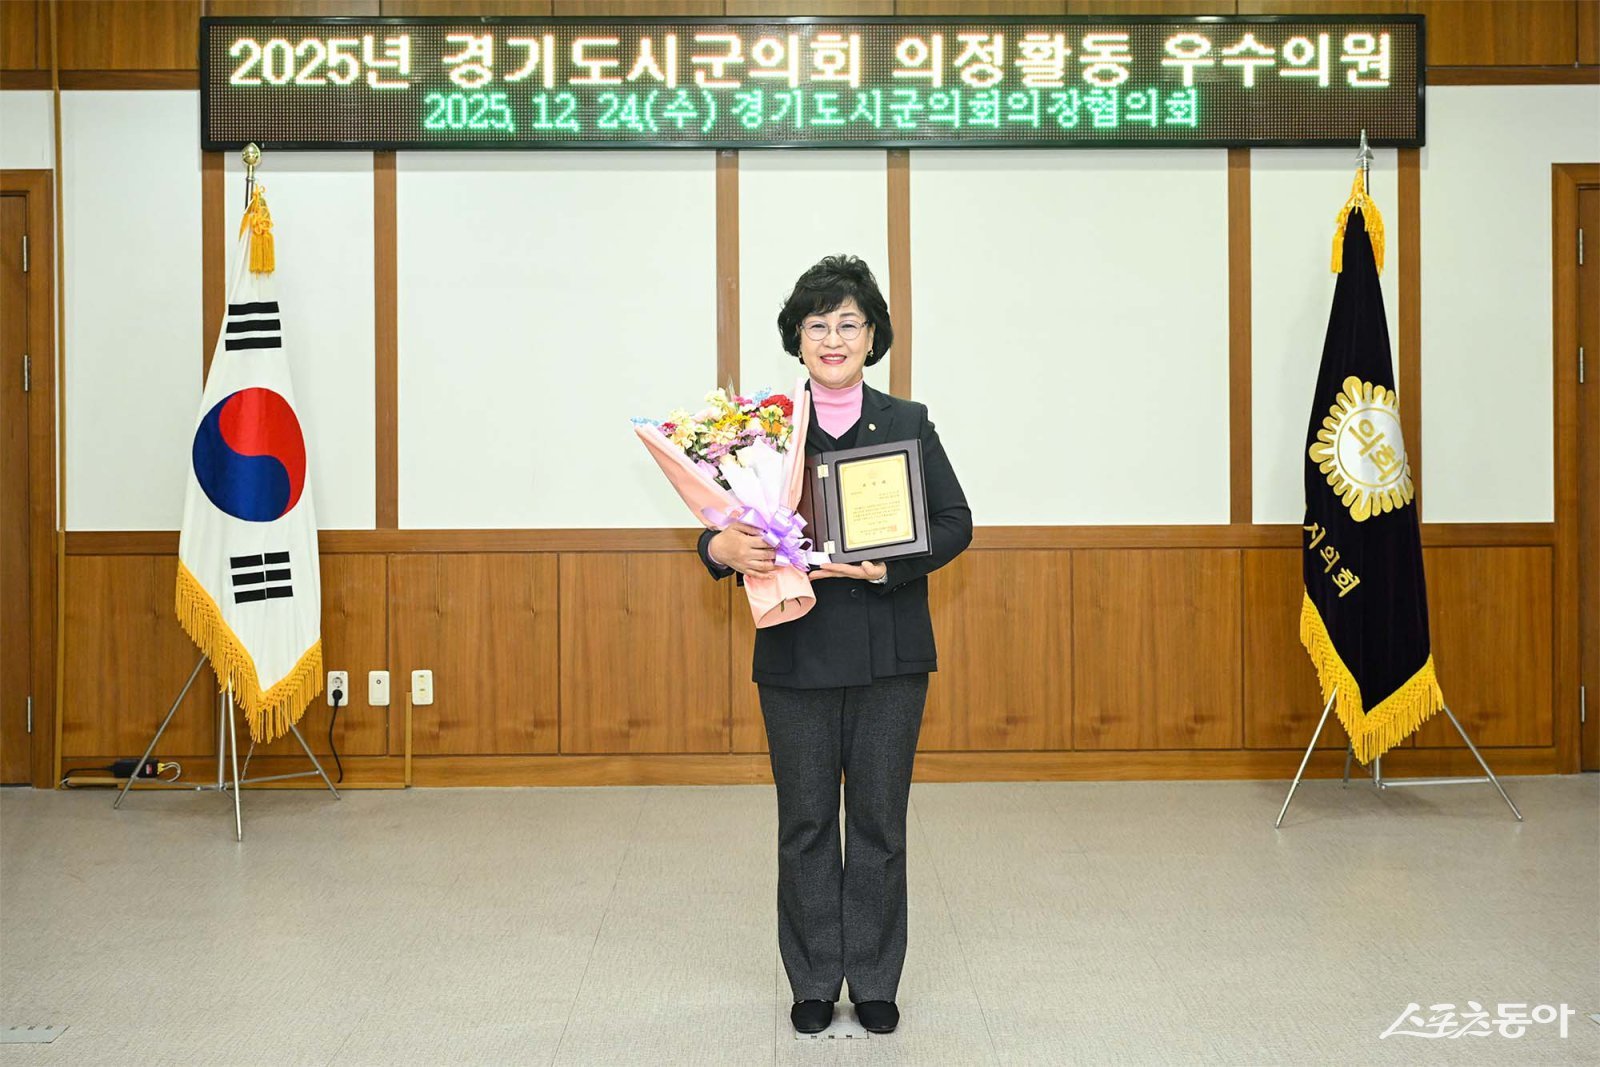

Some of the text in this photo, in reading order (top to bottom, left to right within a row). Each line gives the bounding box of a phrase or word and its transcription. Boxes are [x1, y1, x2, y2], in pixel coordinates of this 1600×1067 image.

[228, 32, 1393, 90] 2025년 경기도시군의회 의정활동 우수의원
[731, 88, 1199, 130] 경기도시군의회의장협의회
[1349, 418, 1402, 481] 의회
